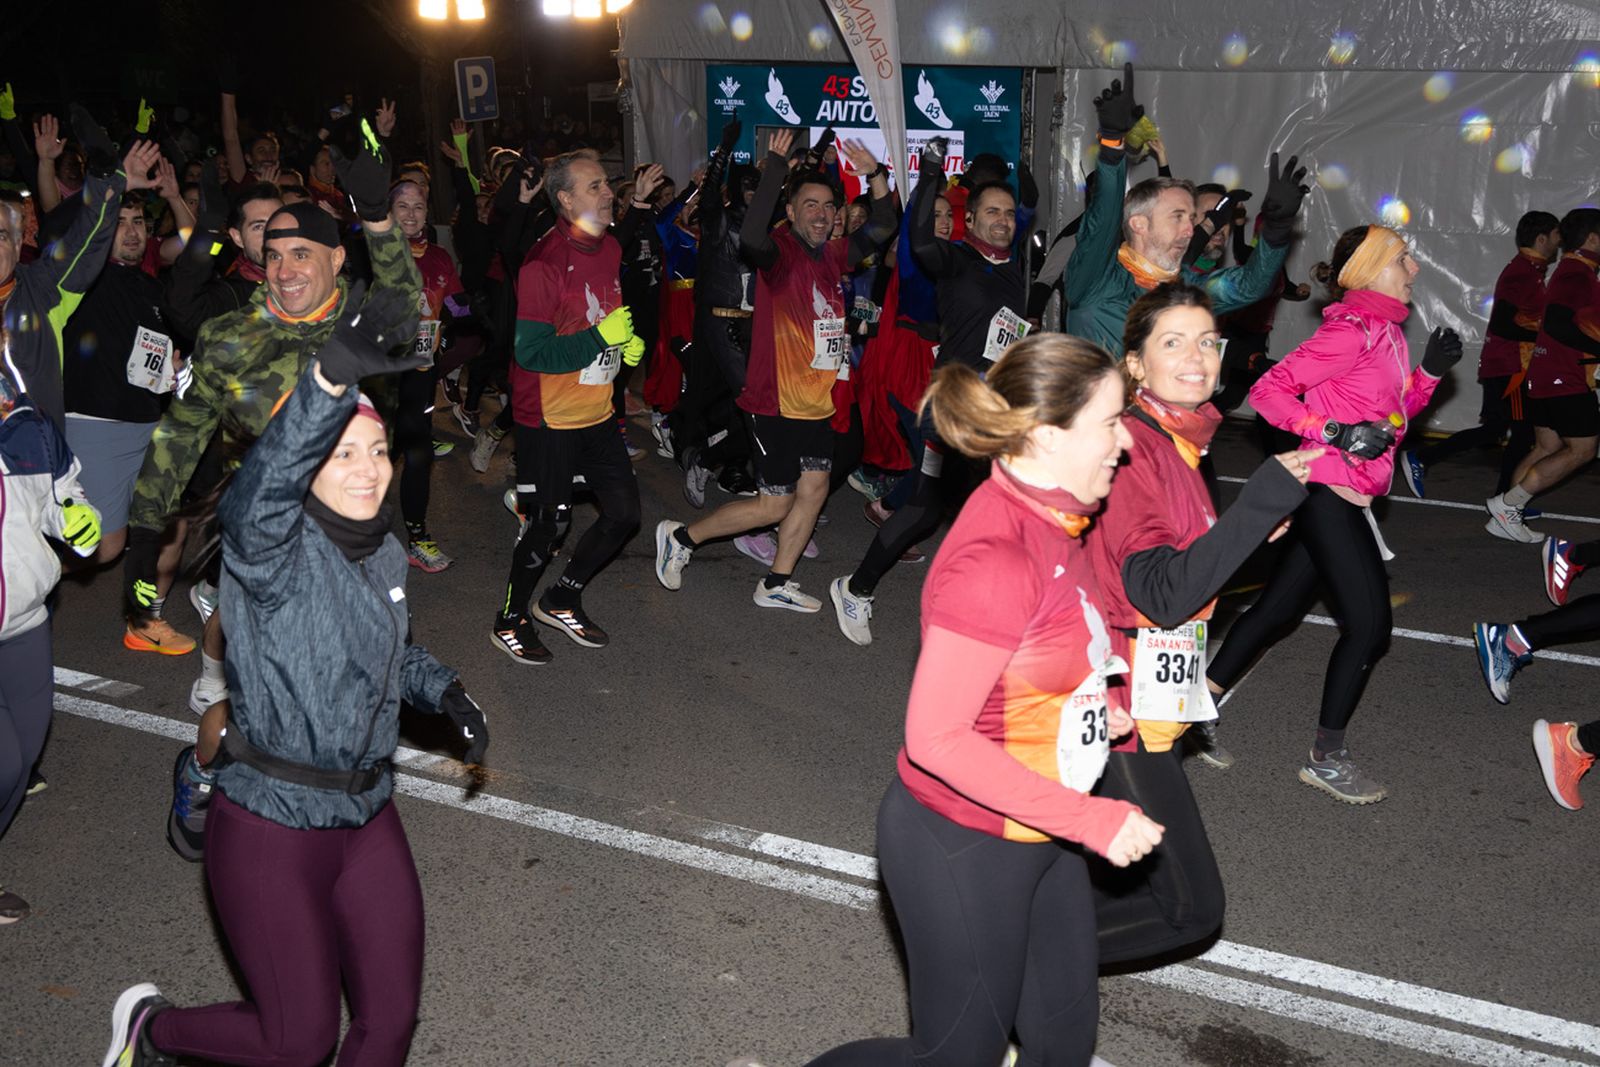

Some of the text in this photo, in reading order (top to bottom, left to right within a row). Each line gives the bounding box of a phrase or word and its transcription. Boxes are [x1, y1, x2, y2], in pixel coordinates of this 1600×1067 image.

[465, 65, 488, 113] P
[822, 75, 850, 99] 43
[776, 99, 789, 115] 43
[816, 100, 880, 122] ANTO
[926, 103, 940, 119] 43
[1147, 638, 1167, 650] SAN
[1156, 652, 1200, 685] 3341
